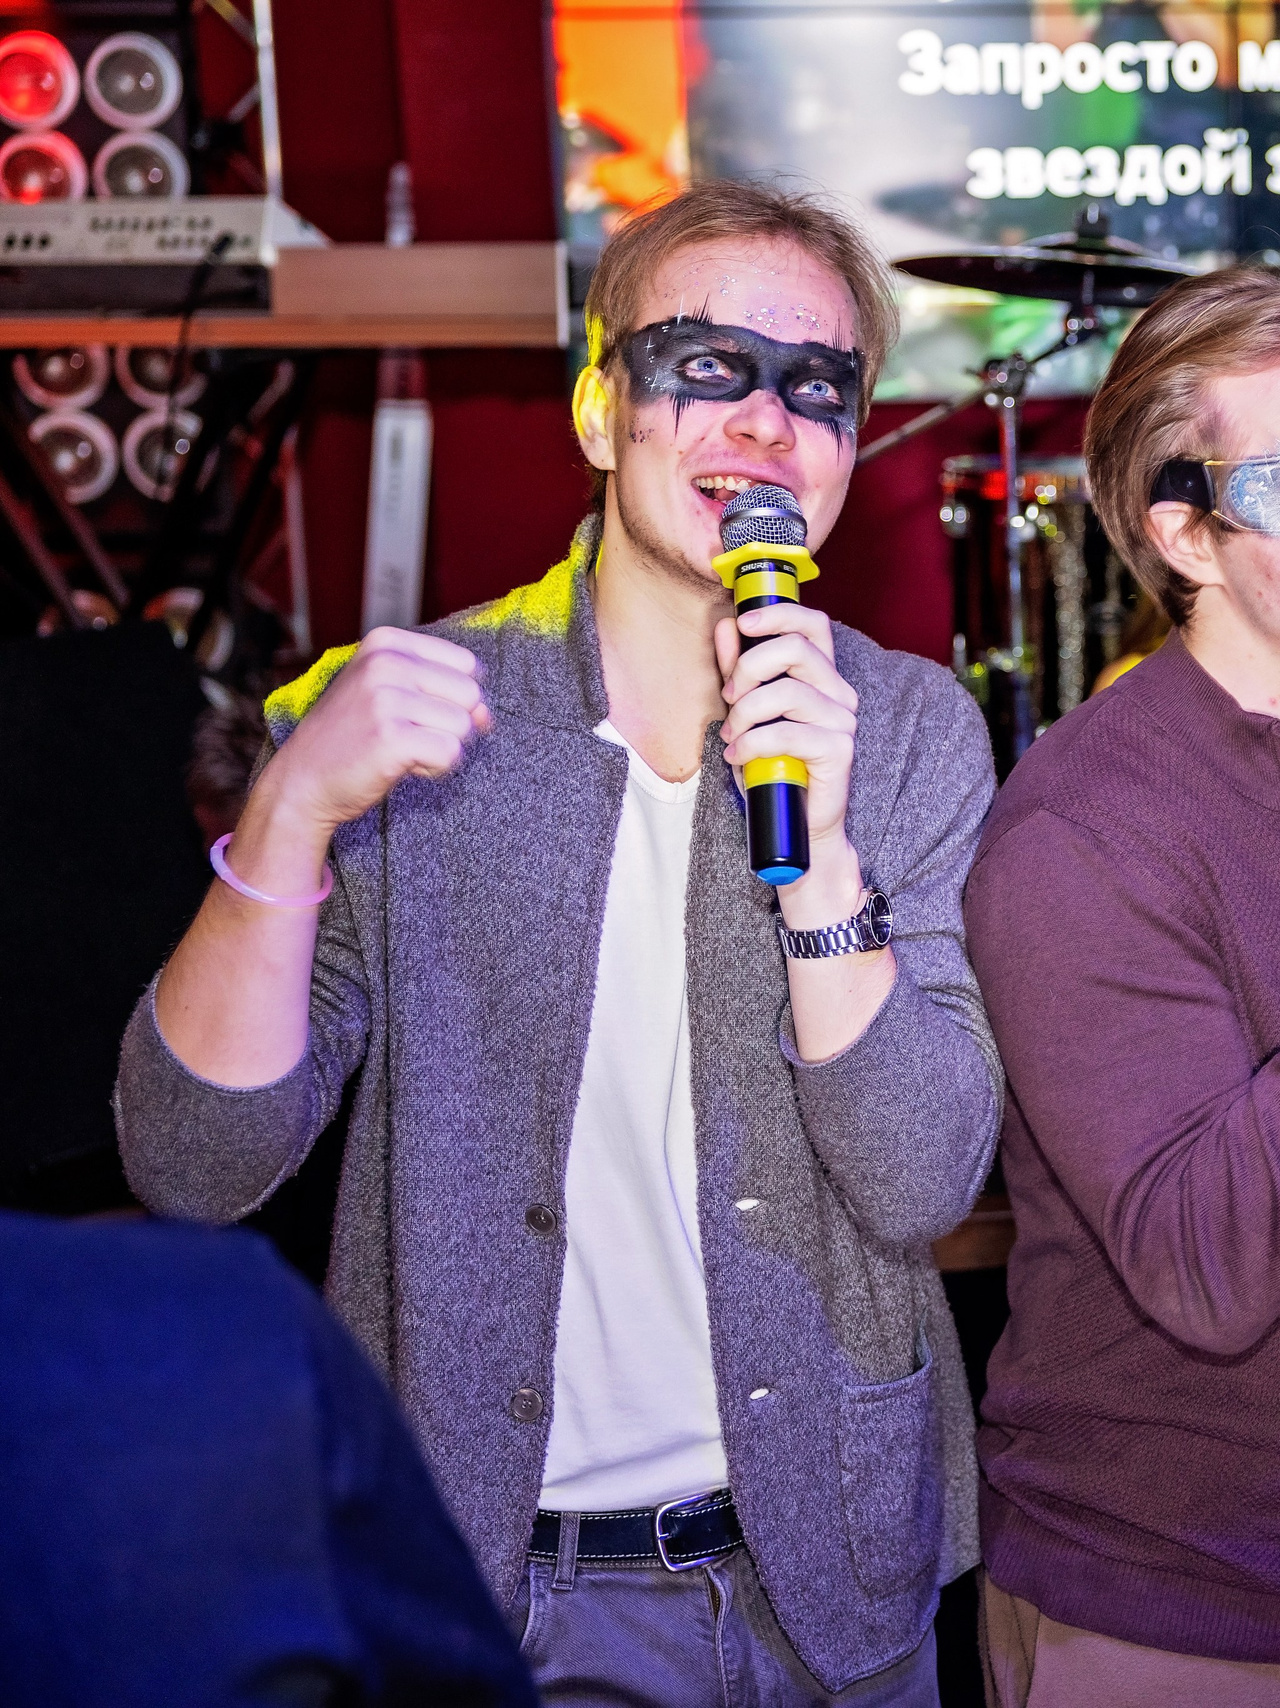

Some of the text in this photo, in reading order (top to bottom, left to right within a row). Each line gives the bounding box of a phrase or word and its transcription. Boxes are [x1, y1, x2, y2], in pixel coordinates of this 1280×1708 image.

[897, 30, 1218, 109] Запросто
[965, 128, 1252, 206] звездой
[741, 561, 770, 573] SHURE
